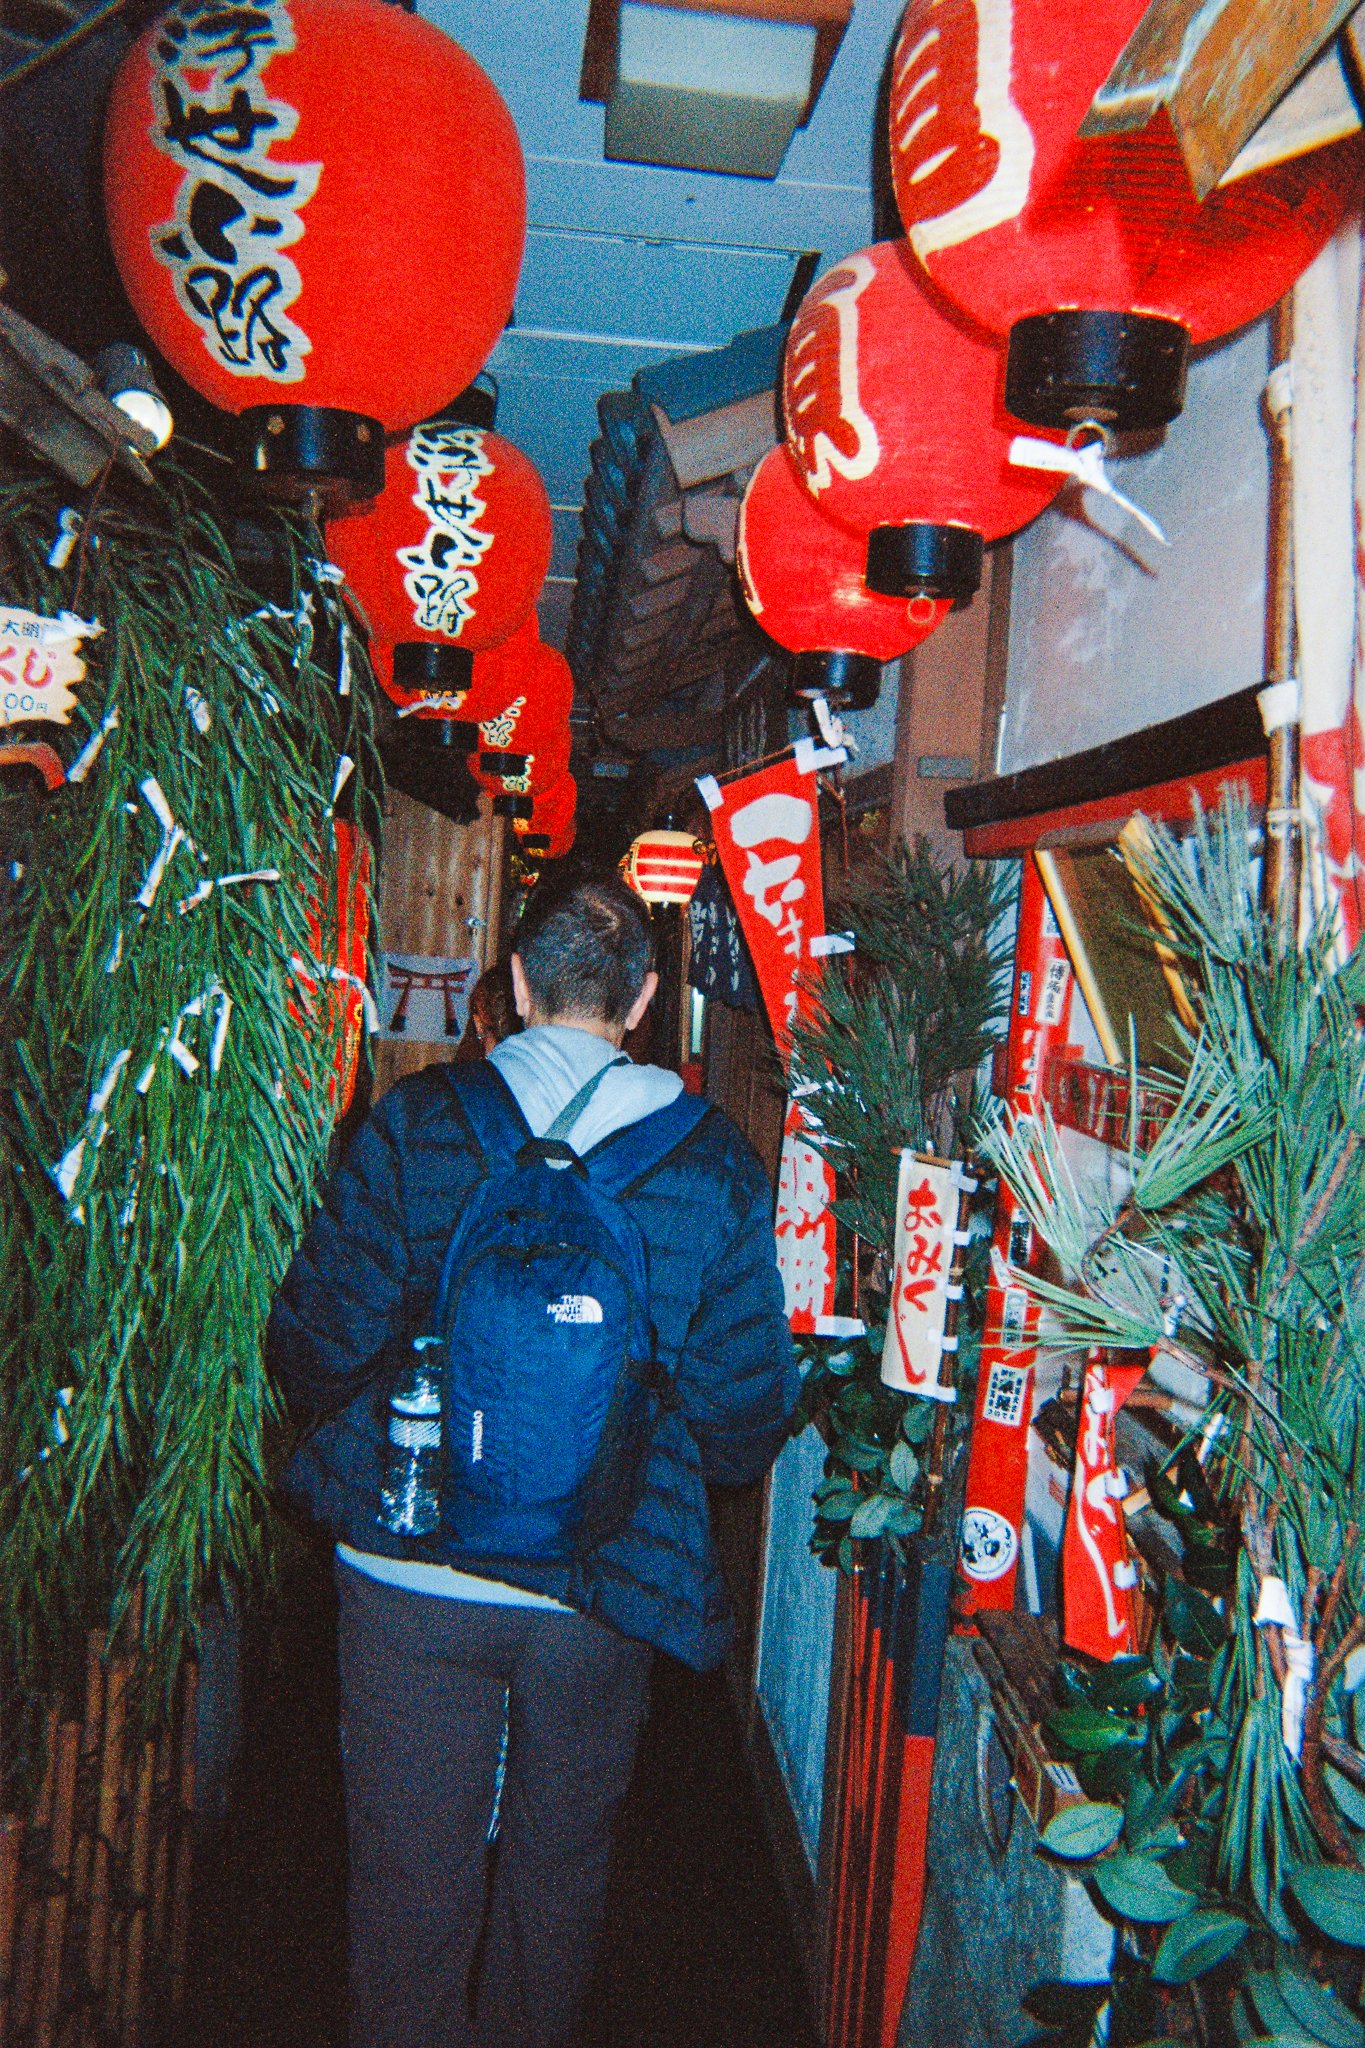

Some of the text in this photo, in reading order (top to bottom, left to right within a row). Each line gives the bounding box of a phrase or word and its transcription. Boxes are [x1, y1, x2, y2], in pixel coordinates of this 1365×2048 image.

[892, 1178, 942, 1385] おみくじ
[560, 1294, 584, 1305] THE
[546, 1303, 583, 1315] NORTH
[554, 1313, 584, 1324] FACE
